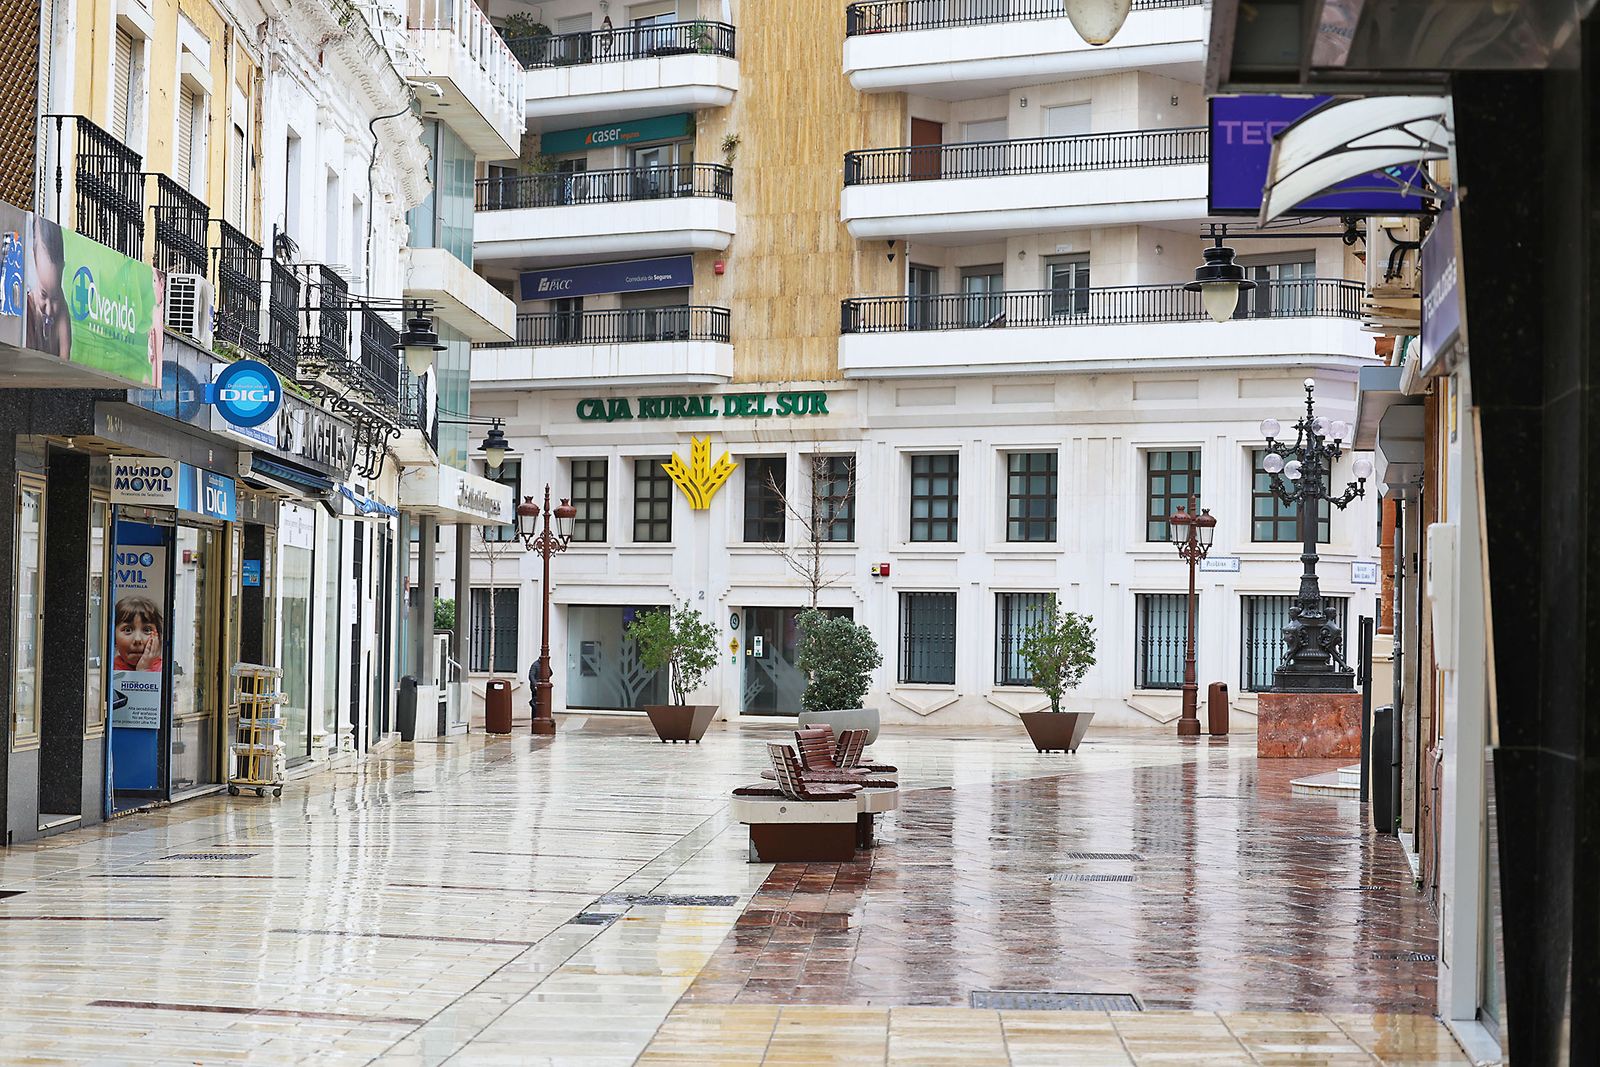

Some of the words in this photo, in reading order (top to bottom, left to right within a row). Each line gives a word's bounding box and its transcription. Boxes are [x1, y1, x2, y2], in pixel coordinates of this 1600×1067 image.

[592, 128, 621, 143] caser
[1218, 120, 1289, 145] TEC
[653, 273, 672, 282] Seguros
[549, 279, 573, 291] PACC
[220, 389, 275, 402] DIGI
[576, 397, 634, 422] CAJA
[637, 394, 719, 419] RURAL
[723, 394, 773, 418] DEL
[776, 392, 830, 416] SUR
[115, 465, 173, 478] MUNDO
[206, 487, 228, 516] DIGI
[698, 590, 705, 600] 2
[121, 682, 159, 690] HIDROGEL
